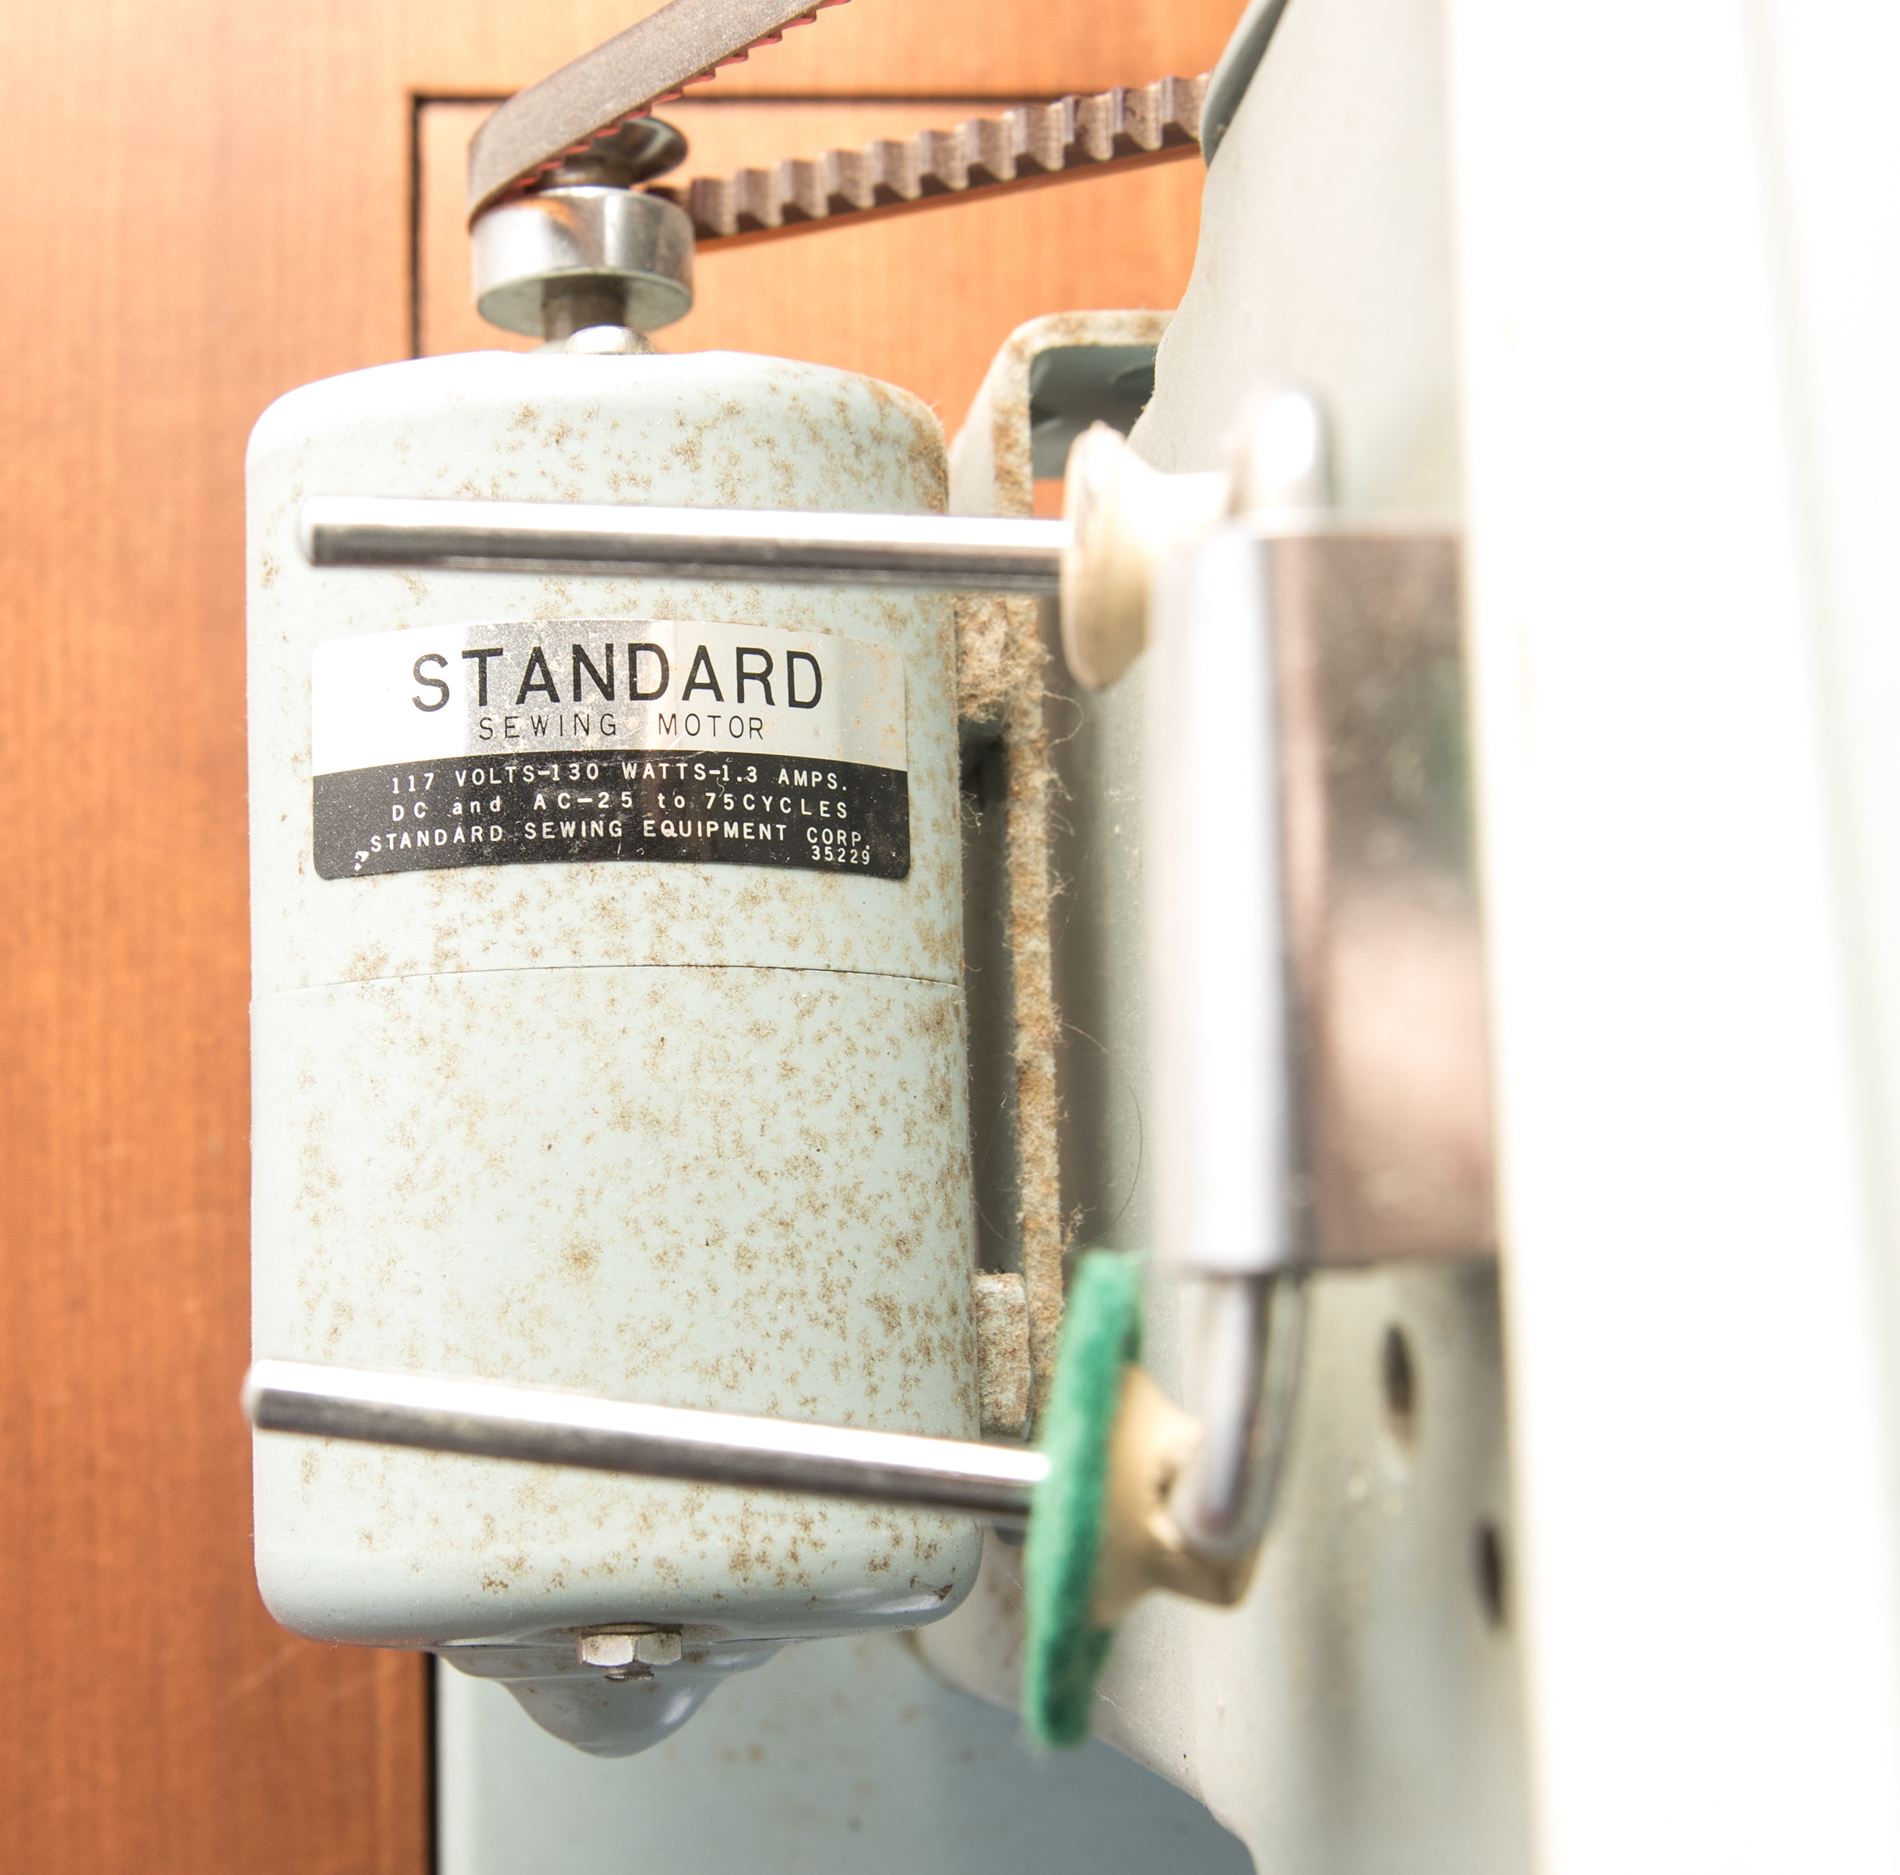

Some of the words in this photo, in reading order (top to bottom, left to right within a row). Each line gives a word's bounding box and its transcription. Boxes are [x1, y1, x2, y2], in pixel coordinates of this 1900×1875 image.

[411, 641, 824, 712] STANDARD
[478, 713, 618, 741] SEWING
[658, 713, 765, 741] MOTOR
[392, 772, 435, 794] 117
[778, 768, 848, 791] AMPS.
[392, 802, 427, 822] DC
[452, 795, 502, 815] and
[658, 792, 686, 809] to
[370, 825, 503, 853] STANDARD
[524, 820, 623, 840] SEWING
[643, 819, 788, 841] EQUIPMENT
[807, 826, 871, 851] CORP.
[811, 845, 871, 865] 35229
